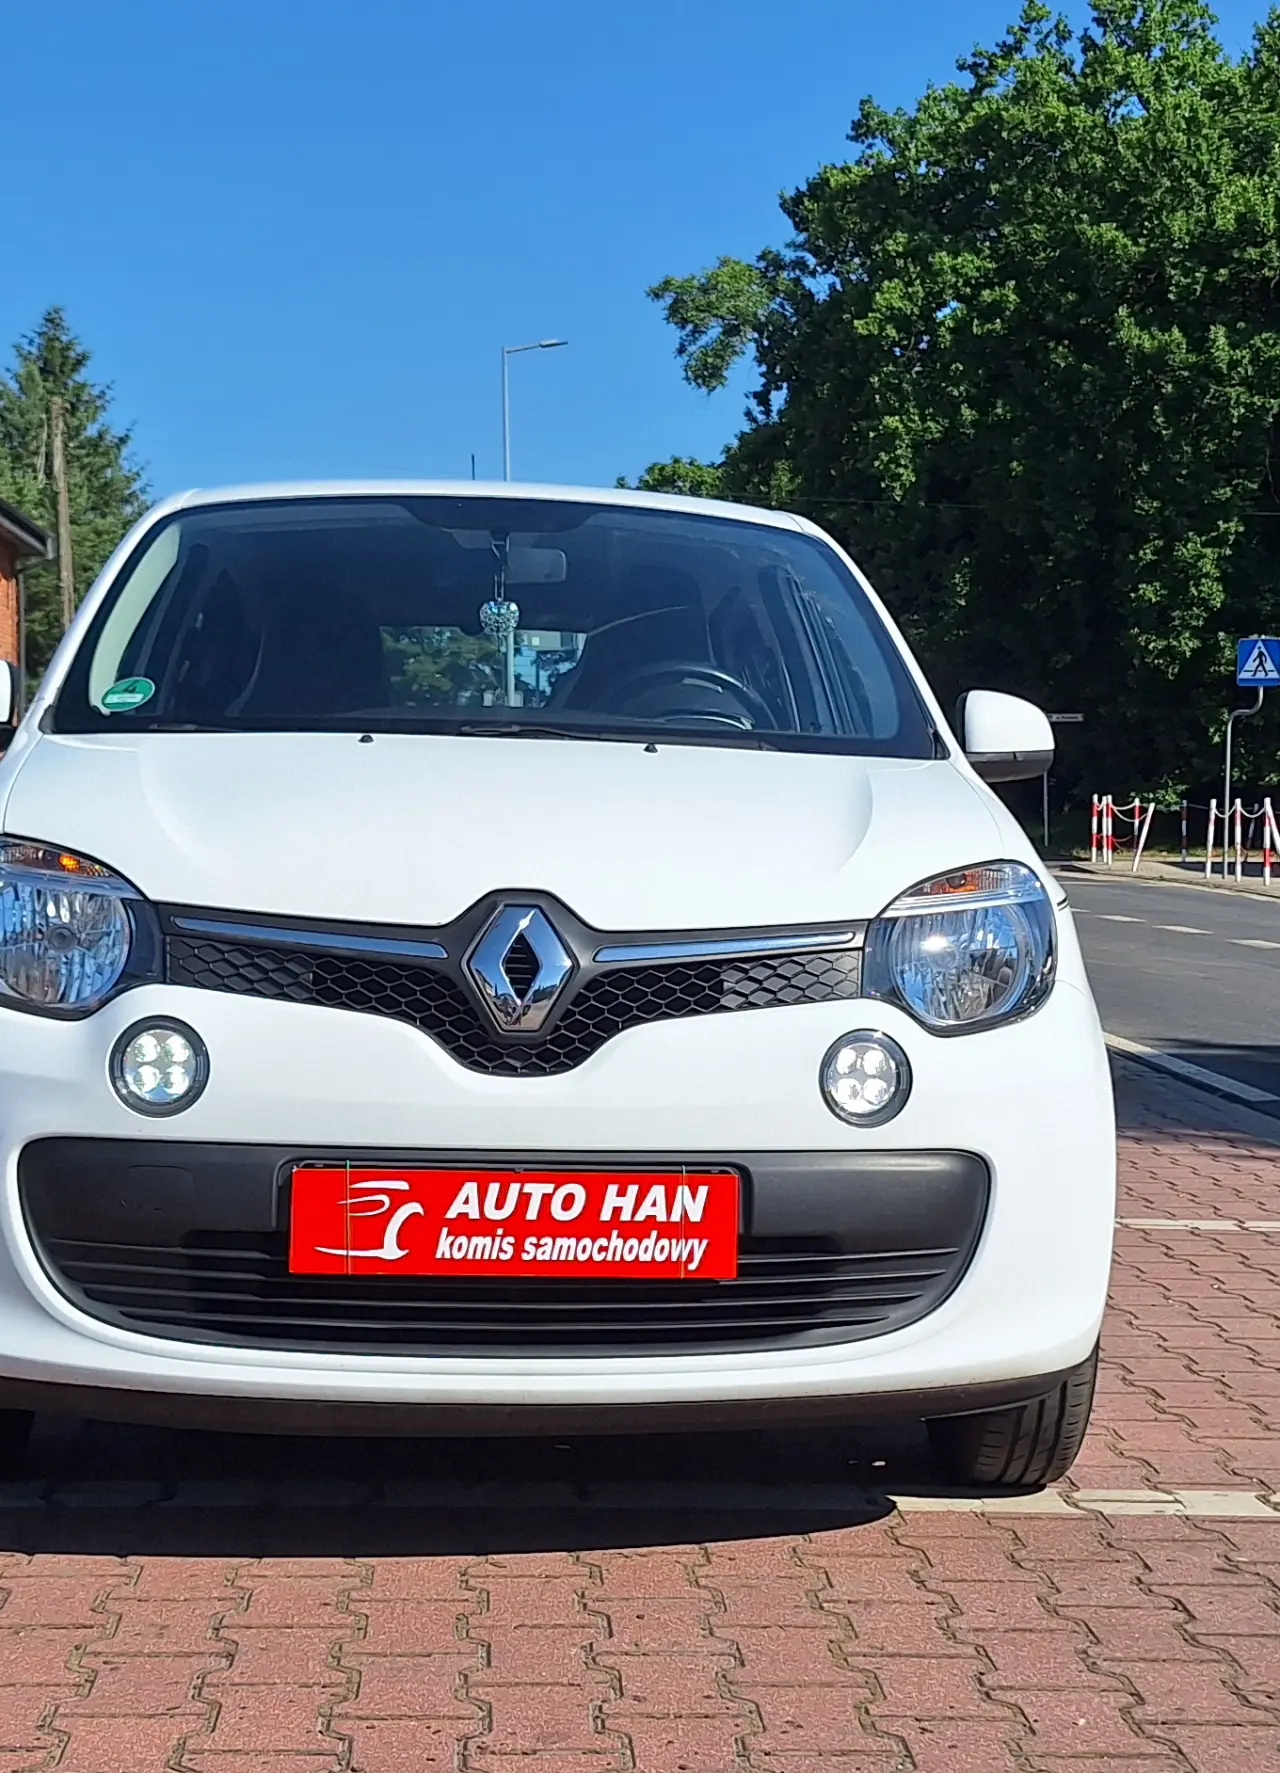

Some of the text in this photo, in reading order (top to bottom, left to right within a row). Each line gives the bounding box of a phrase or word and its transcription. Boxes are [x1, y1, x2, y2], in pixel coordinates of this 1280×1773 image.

[445, 1182, 709, 1223] AUTO HAN
[435, 1228, 708, 1270] komis samochodowy
